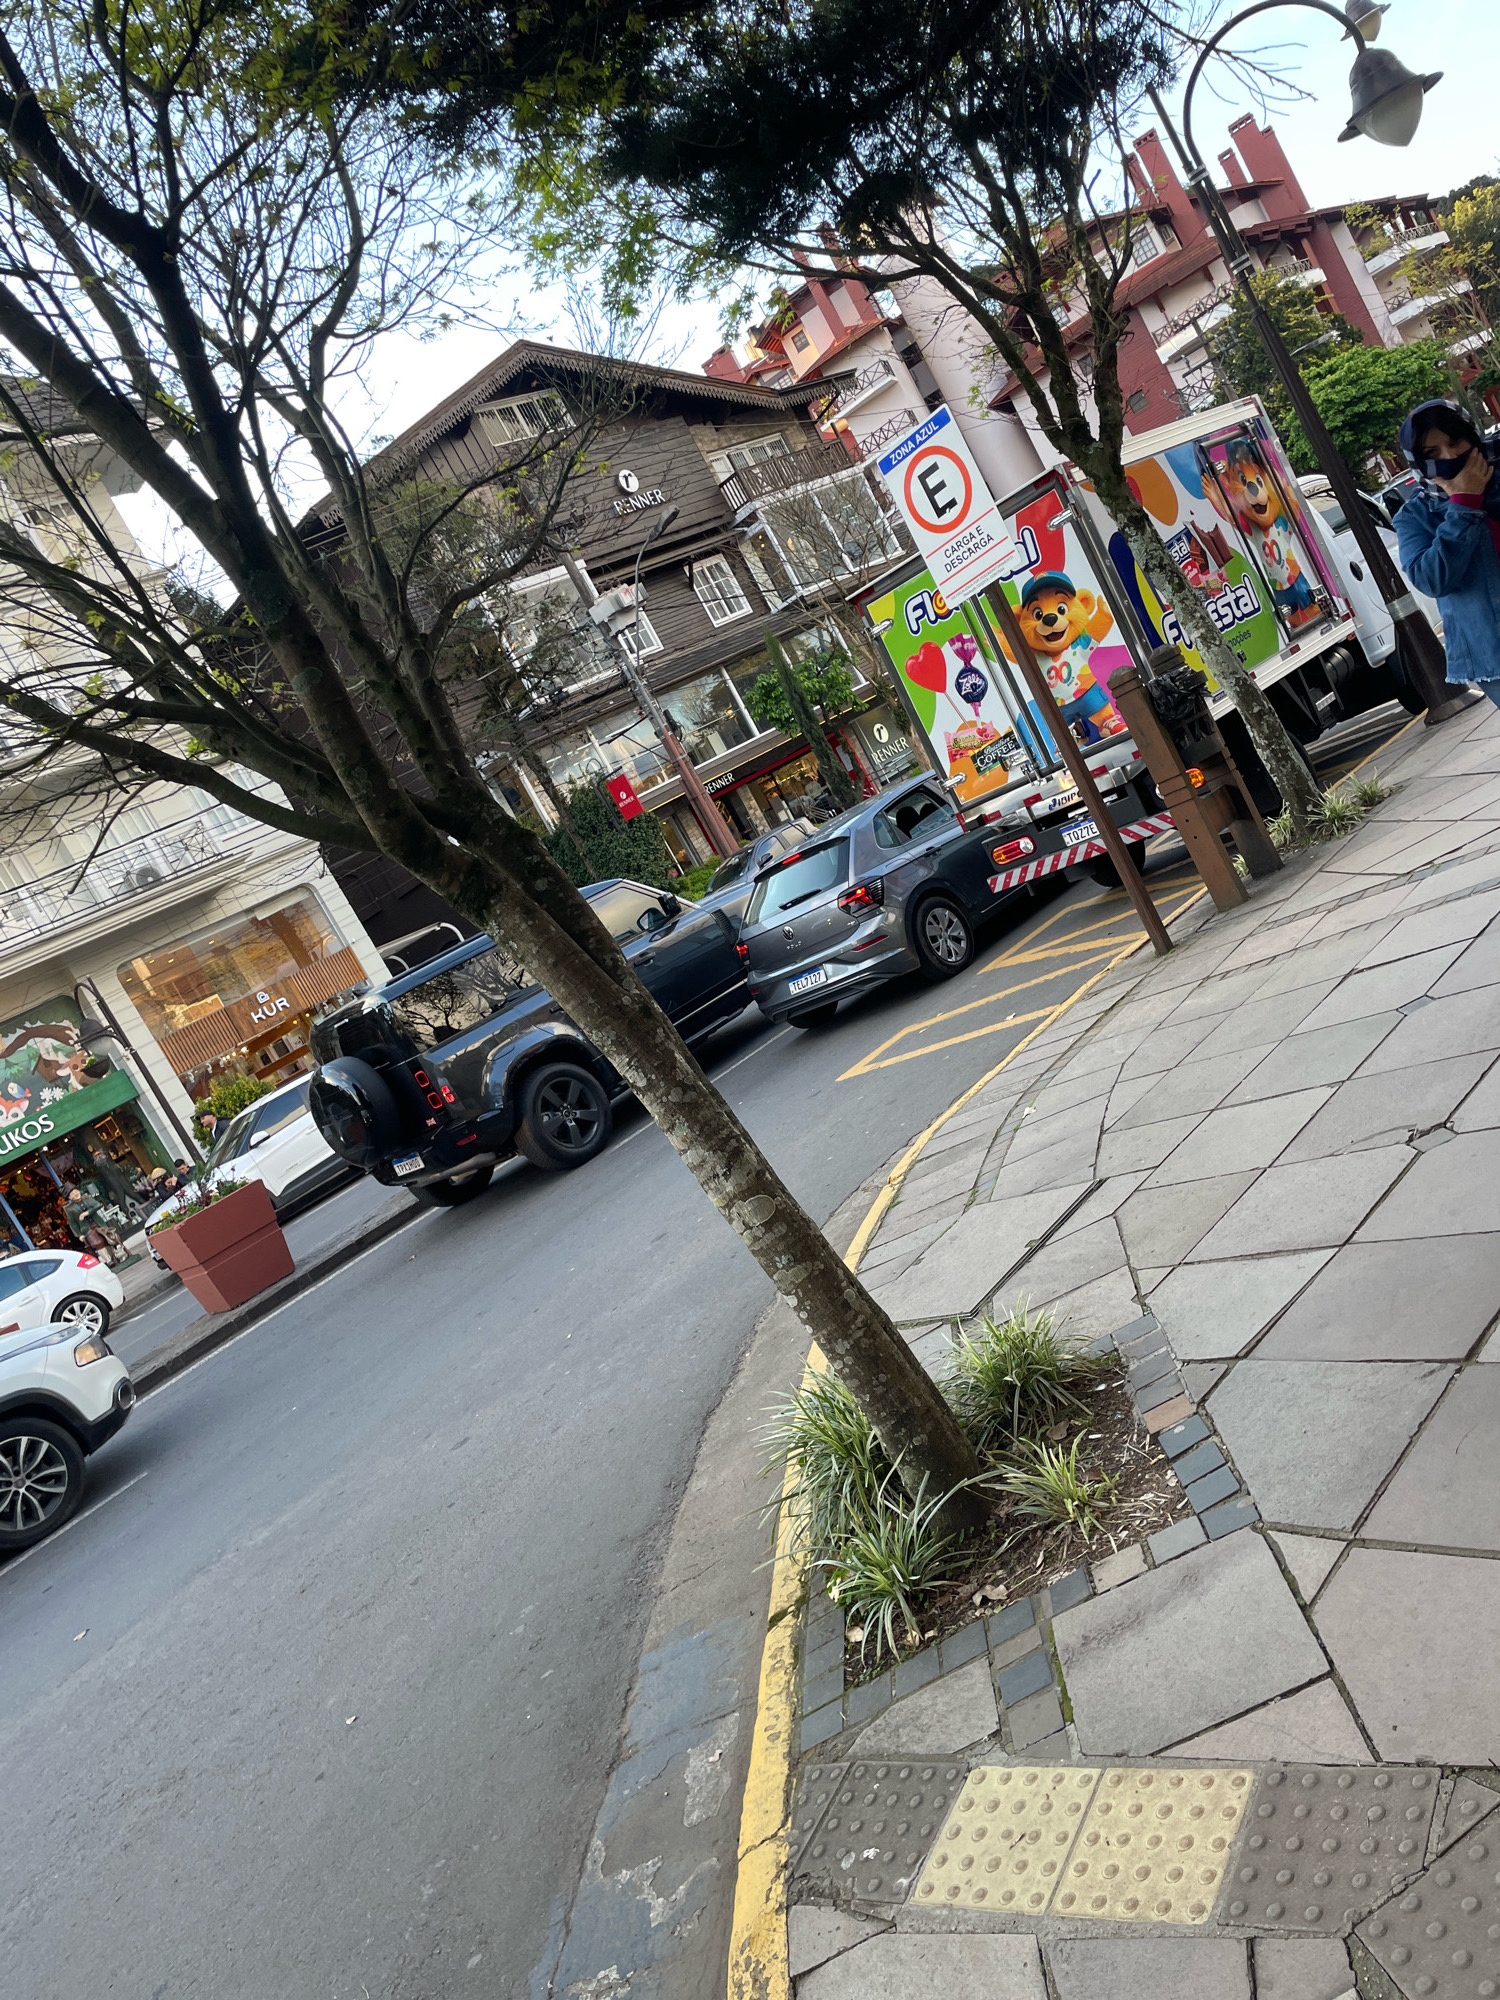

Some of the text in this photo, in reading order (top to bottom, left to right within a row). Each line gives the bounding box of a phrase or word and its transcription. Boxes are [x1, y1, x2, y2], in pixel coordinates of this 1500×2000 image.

[889, 421, 939, 466] ZONA AZUL
[613, 488, 666, 515] RENNER
[917, 461, 958, 519] E
[944, 525, 985, 560] CARGA E
[944, 533, 994, 574] DESCARGA
[1262, 539, 1282, 568] 90
[1047, 660, 1072, 689] 90
[871, 737, 909, 765] RENNER
[977, 743, 1017, 767] COFFEE
[704, 772, 735, 794] RENNER
[1066, 823, 1098, 843] TQZ7E
[251, 997, 290, 1023] KUR
